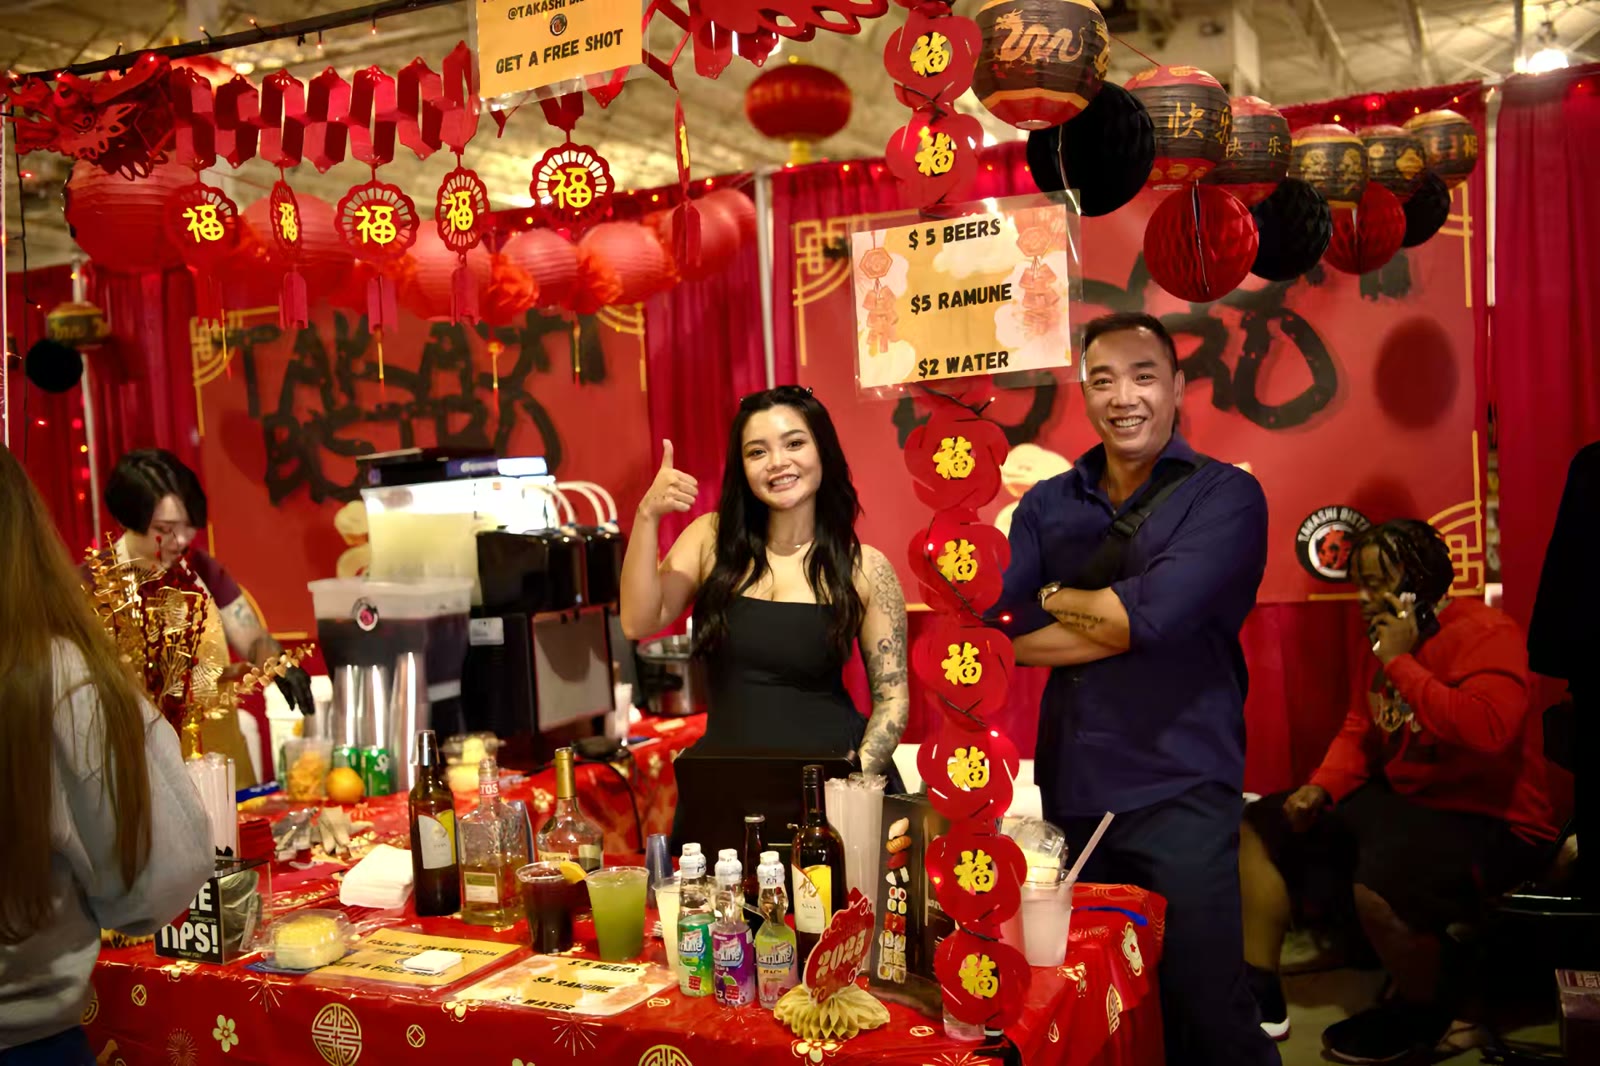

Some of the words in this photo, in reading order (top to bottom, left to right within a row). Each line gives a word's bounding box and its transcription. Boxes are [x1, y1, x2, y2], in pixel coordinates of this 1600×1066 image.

[496, 54, 524, 74] GET
[528, 51, 539, 67] A
[543, 39, 580, 63] FREE
[585, 29, 624, 52] SHOT
[910, 31, 951, 77] 福
[1168, 102, 1206, 138] 快
[915, 132, 956, 176] 福
[551, 167, 592, 209] 福
[182, 203, 225, 243] 福
[354, 205, 397, 245] 福
[445, 190, 474, 231] 福
[908, 229, 919, 250] $
[926, 228, 936, 246] 5
[943, 217, 1001, 244] BEERS
[910, 294, 932, 315] $5
[938, 282, 1013, 310] RAMUNE
[918, 358, 940, 379] $2
[946, 350, 1009, 374] WATER
[933, 436, 975, 480] 福
[937, 539, 978, 581] 福
[941, 642, 982, 686] 福
[947, 746, 990, 789] 福
[953, 849, 995, 893] 福
[959, 953, 999, 998] 福
